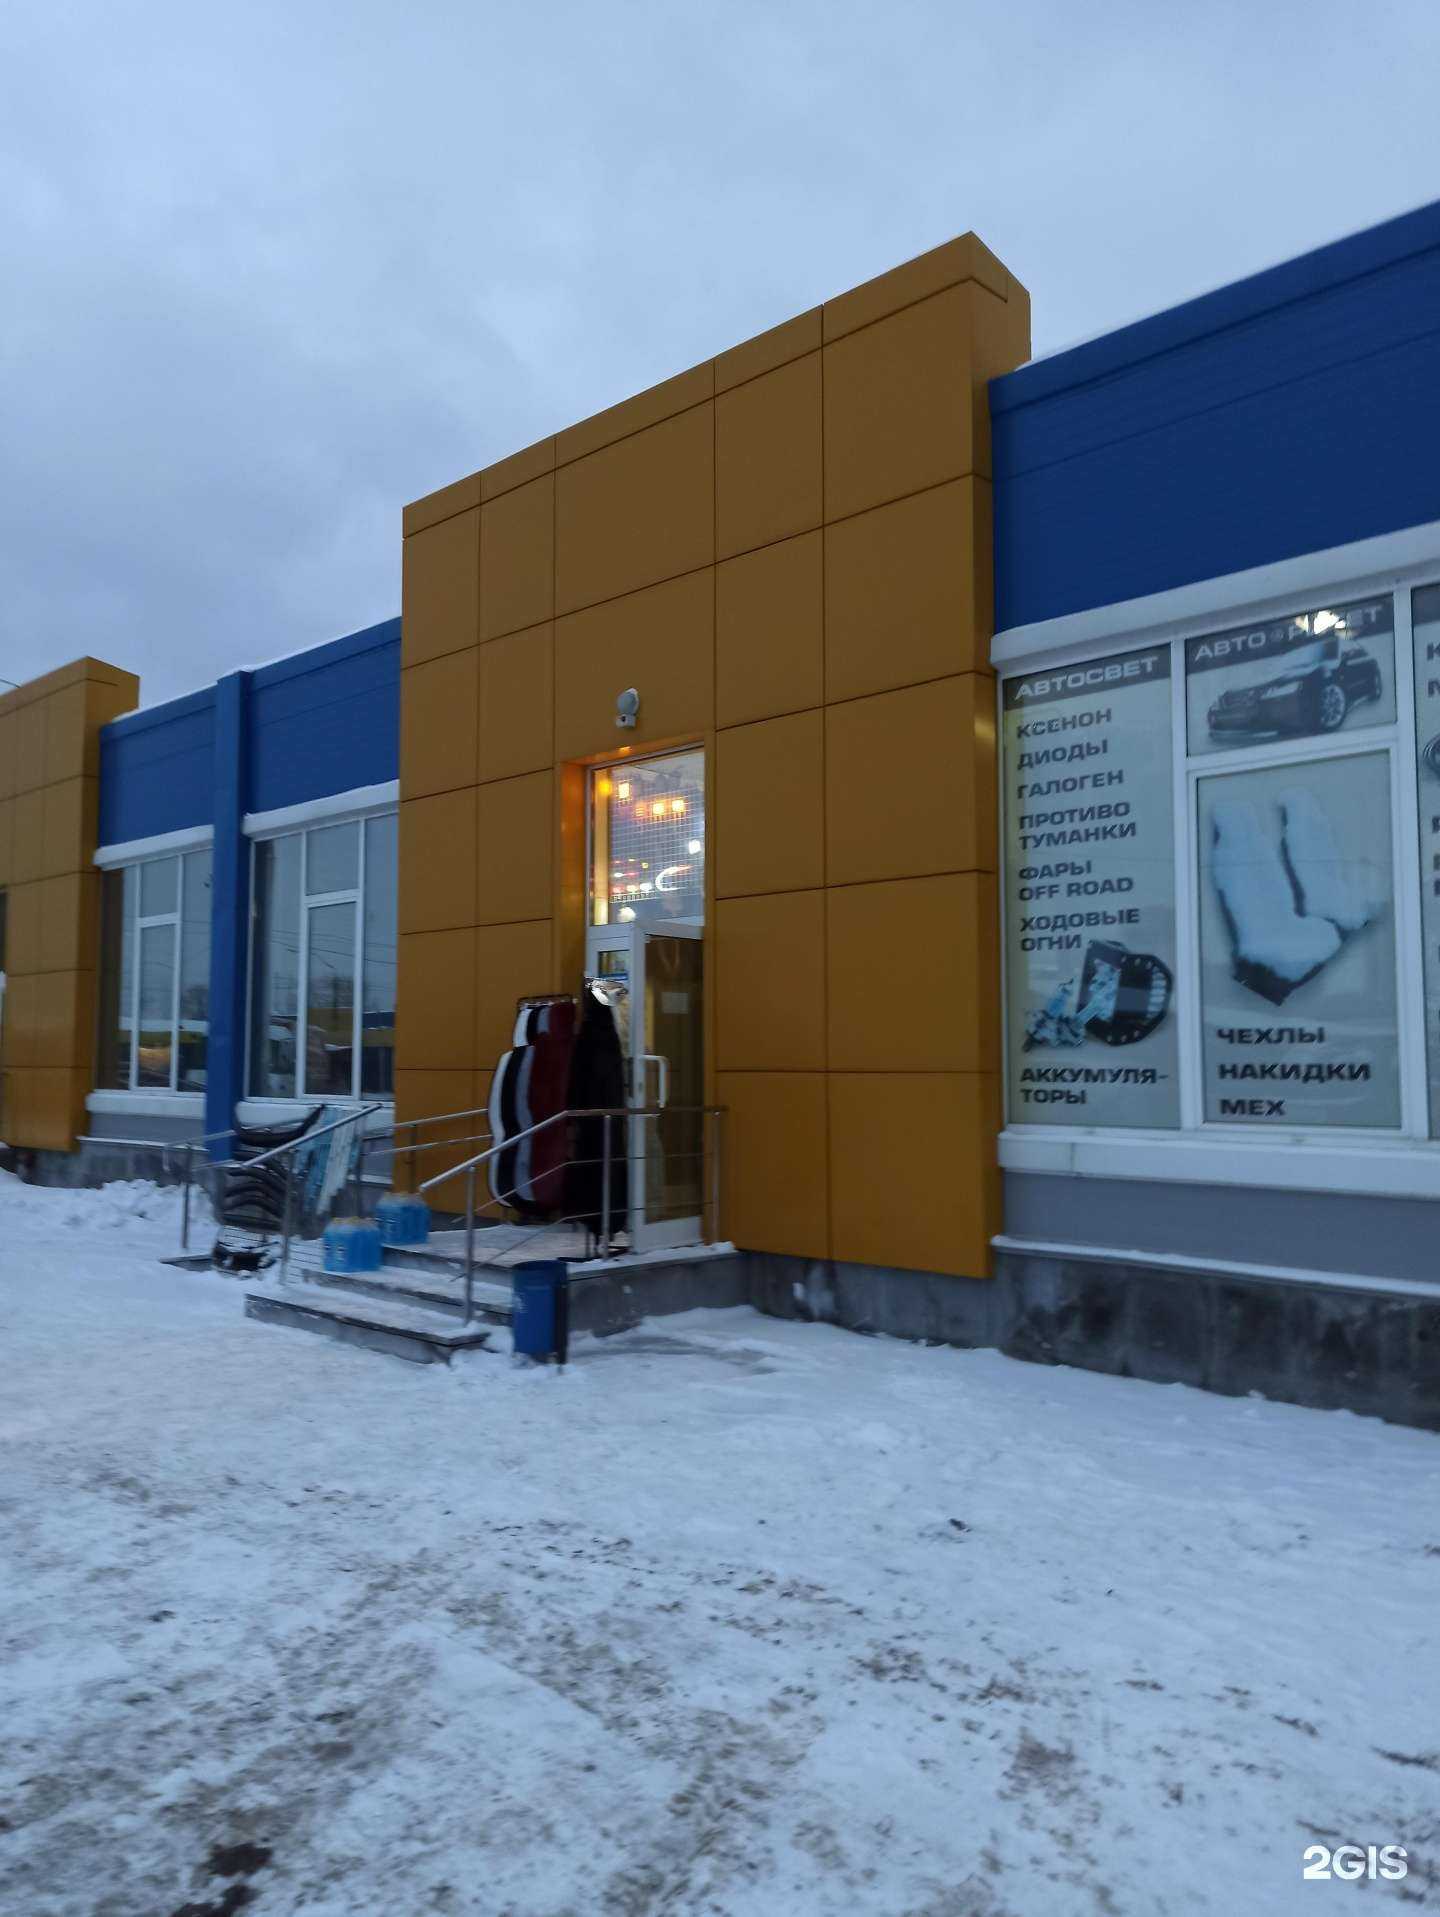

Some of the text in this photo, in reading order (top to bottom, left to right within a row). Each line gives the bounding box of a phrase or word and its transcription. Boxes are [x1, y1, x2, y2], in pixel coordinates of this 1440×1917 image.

[1194, 631, 1266, 661] АВТО
[1015, 656, 1159, 700] АВТОСВЕТ
[1016, 708, 1112, 739] КСЕНОН
[1017, 739, 1108, 770] ДИОДЫ
[1016, 769, 1124, 799] ГАЛОГЕН
[1019, 801, 1130, 830] ПРОТИВО
[1019, 822, 1137, 850] ТУМАНКИ
[1018, 860, 1092, 880] ФАРЫ
[1018, 876, 1133, 901] OFF ROAD
[1020, 908, 1140, 932] ХОДОВЫЕ
[1020, 934, 1082, 951] ОГНИ
[1217, 1027, 1326, 1044] ЧЕХЛЫ
[1218, 1063, 1371, 1083] НАКИДКИ
[1020, 1089, 1087, 1104] ТОРЫ
[1220, 1099, 1286, 1116] МЕХ
